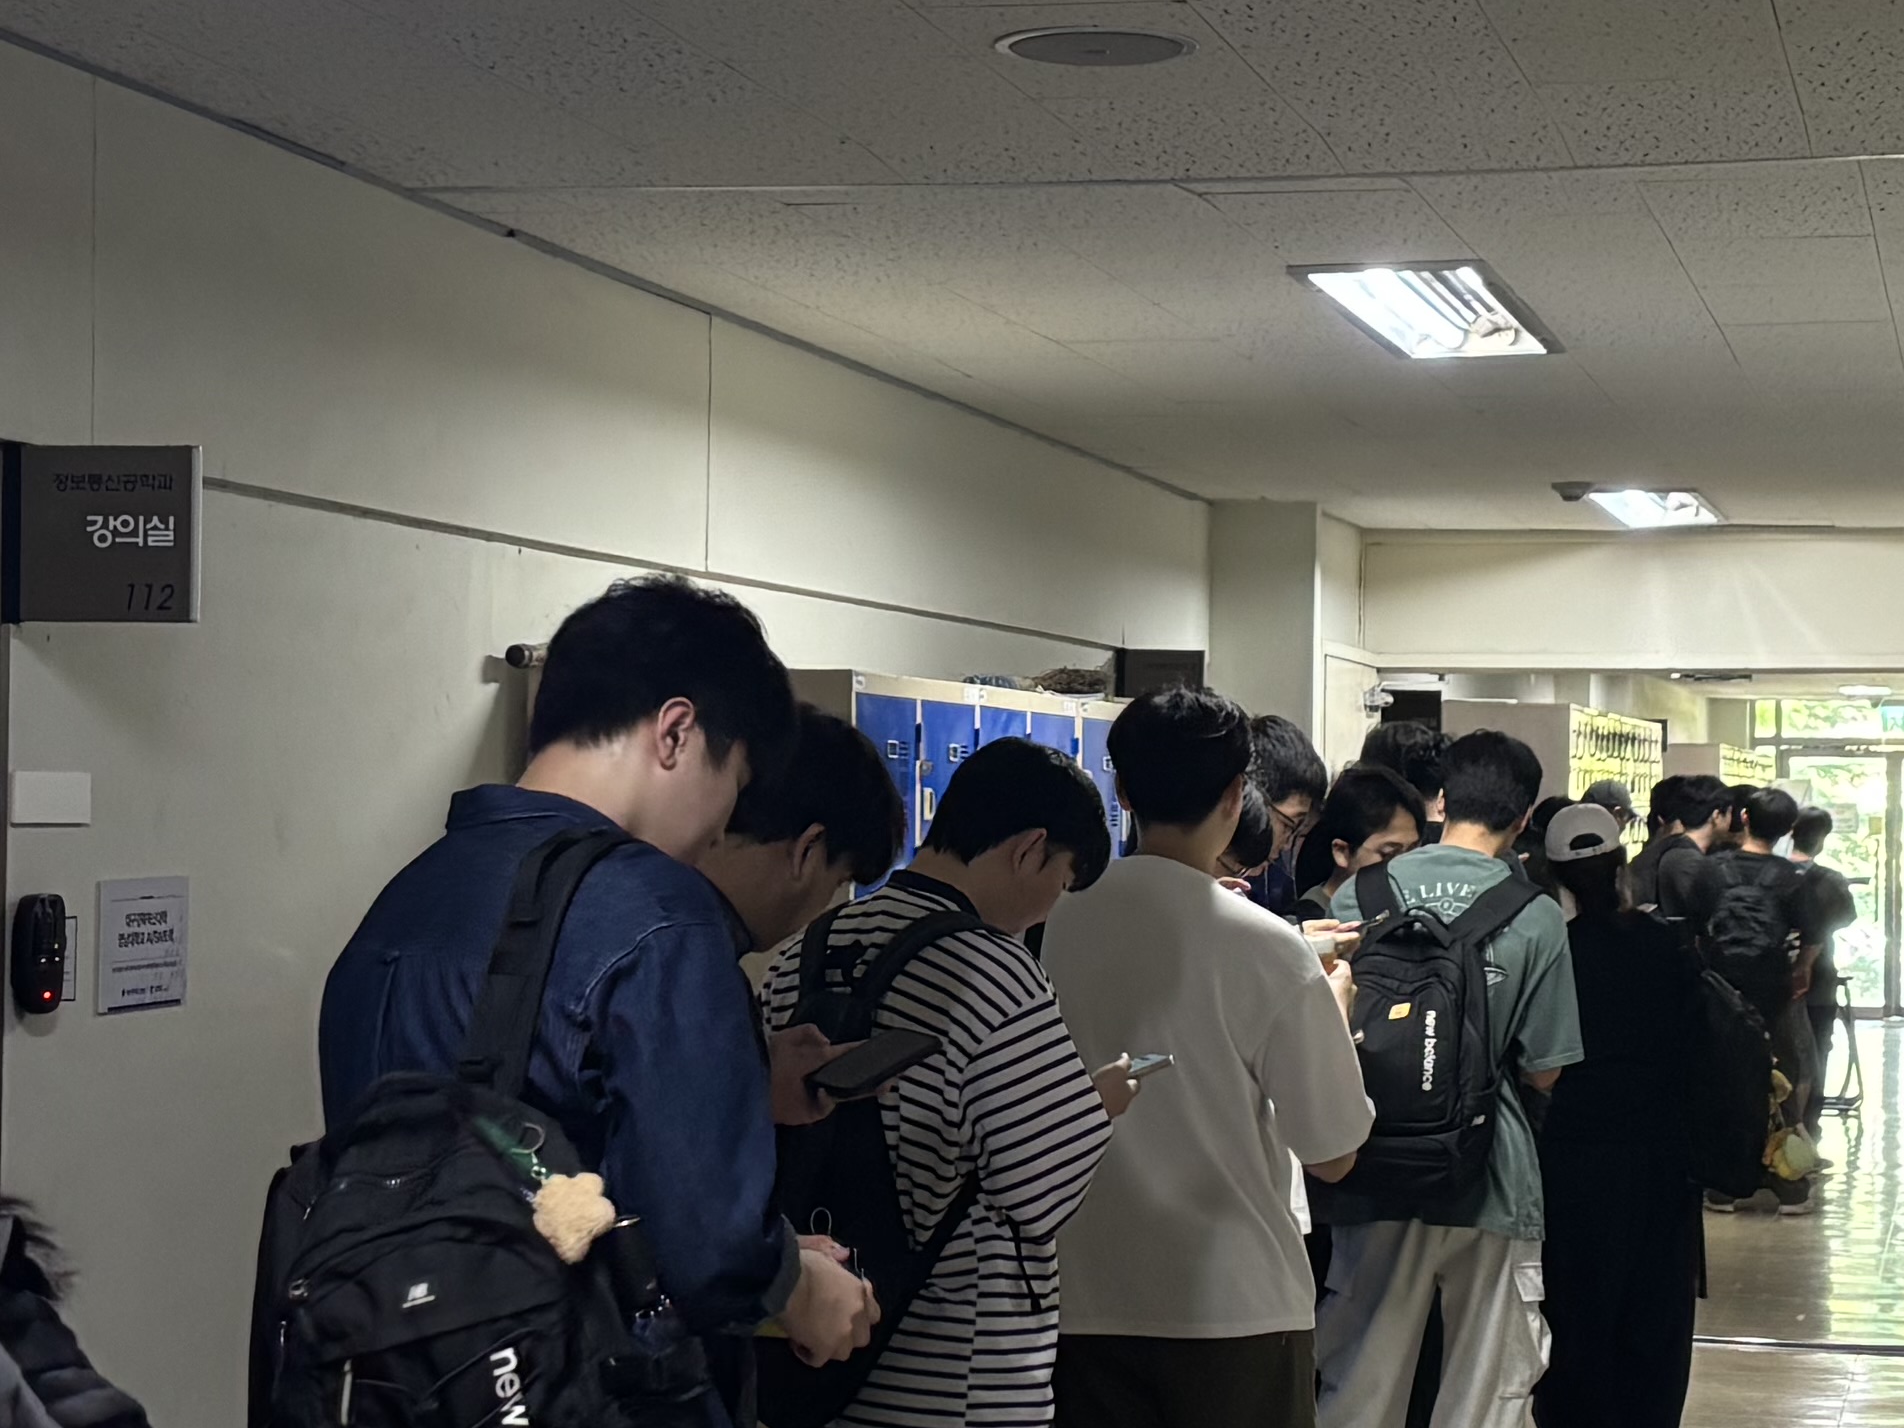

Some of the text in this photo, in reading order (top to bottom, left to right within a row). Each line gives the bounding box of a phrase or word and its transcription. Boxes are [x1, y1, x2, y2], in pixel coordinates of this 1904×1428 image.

[53, 473, 174, 492] 정보통신공학과
[86, 513, 175, 549] 강의실
[127, 583, 175, 612] 112
[1419, 882, 1477, 899] LIVE
[489, 1347, 530, 1426] new
